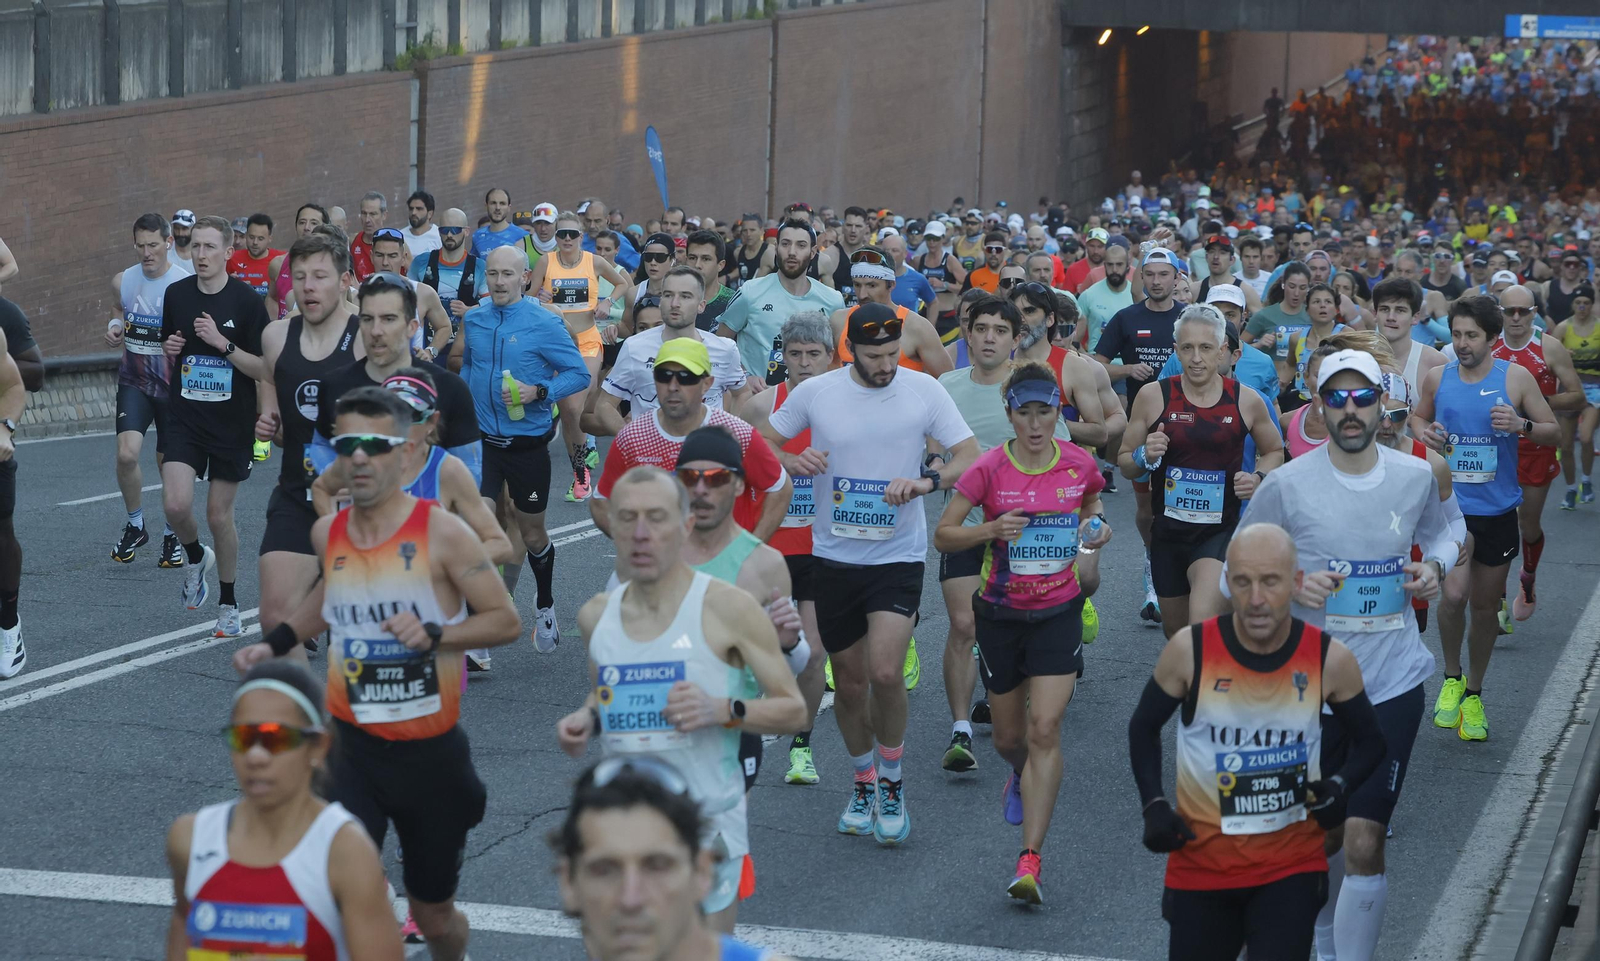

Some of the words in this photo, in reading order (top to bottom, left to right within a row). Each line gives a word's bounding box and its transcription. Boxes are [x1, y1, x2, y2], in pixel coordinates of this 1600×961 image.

[563, 295, 577, 303] JET
[135, 316, 160, 325] ZURICH
[340, 332, 352, 352] soar
[1161, 347, 1173, 355] THE
[199, 358, 228, 366] ZURICH
[198, 371, 214, 379] 5048
[187, 379, 225, 391] CALLUM
[1461, 436, 1491, 444] ZURICH
[1462, 450, 1478, 458] 4458
[1457, 460, 1483, 471] FRAN
[1185, 472, 1219, 482] ZURICH
[794, 493, 812, 502] 5883
[1185, 487, 1203, 497] 6450
[854, 500, 874, 510] 5866
[1175, 497, 1211, 511] PETER
[833, 509, 896, 526] GRZEGORZ
[1033, 517, 1072, 526] ZURICH
[1033, 534, 1055, 543] 4787
[1009, 545, 1078, 559] MERCEDES
[1357, 562, 1397, 575] ZURICH
[1357, 585, 1381, 597] 4599
[1358, 600, 1378, 615] JP
[376, 666, 405, 681] 3772
[624, 666, 676, 682] ZURICH
[360, 678, 427, 702] JUANJE
[627, 693, 655, 707] 7734
[1248, 749, 1298, 768] ZURICH
[1251, 776, 1280, 792] 3796
[1233, 789, 1296, 814] INIESTA
[220, 909, 291, 931] ZURICH
